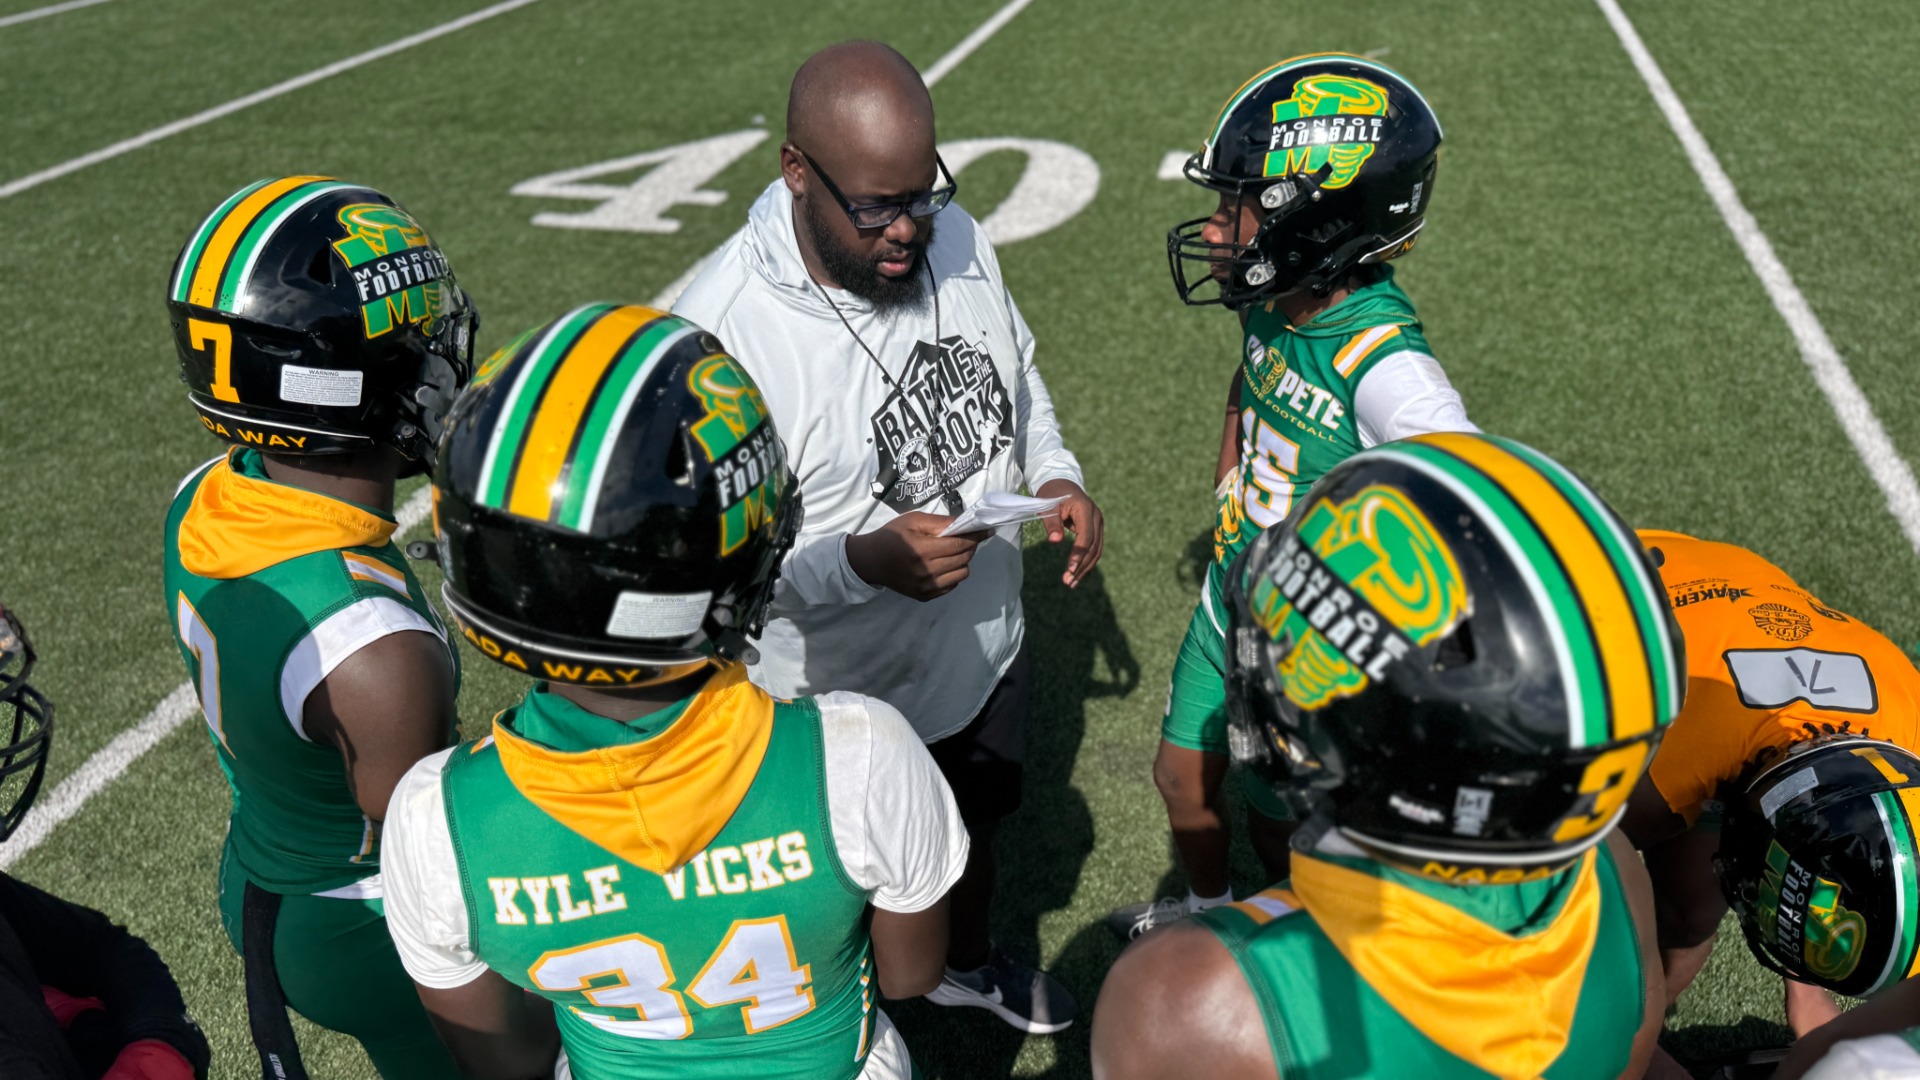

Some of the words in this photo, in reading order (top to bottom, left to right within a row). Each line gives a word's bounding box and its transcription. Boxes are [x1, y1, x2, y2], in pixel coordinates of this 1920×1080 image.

[1272, 117, 1383, 135] MONROE
[188, 317, 241, 404] 7
[308, 369, 340, 377] WARNING
[971, 351, 984, 369] AT
[976, 359, 993, 381] THE
[1265, 399, 1338, 443] FOOTBALL
[1274, 367, 1344, 431] PETE
[237, 428, 307, 448] WAY
[932, 376, 1004, 473] ROCK
[715, 426, 773, 481] MONR
[1674, 584, 1743, 608] BAKER
[543, 661, 640, 682] WAY
[1552, 739, 1650, 844] 3
[487, 864, 628, 926] KYLE
[661, 830, 814, 901] VICKS
[1791, 871, 1812, 964] MONROE
[527, 913, 817, 1041] 34
